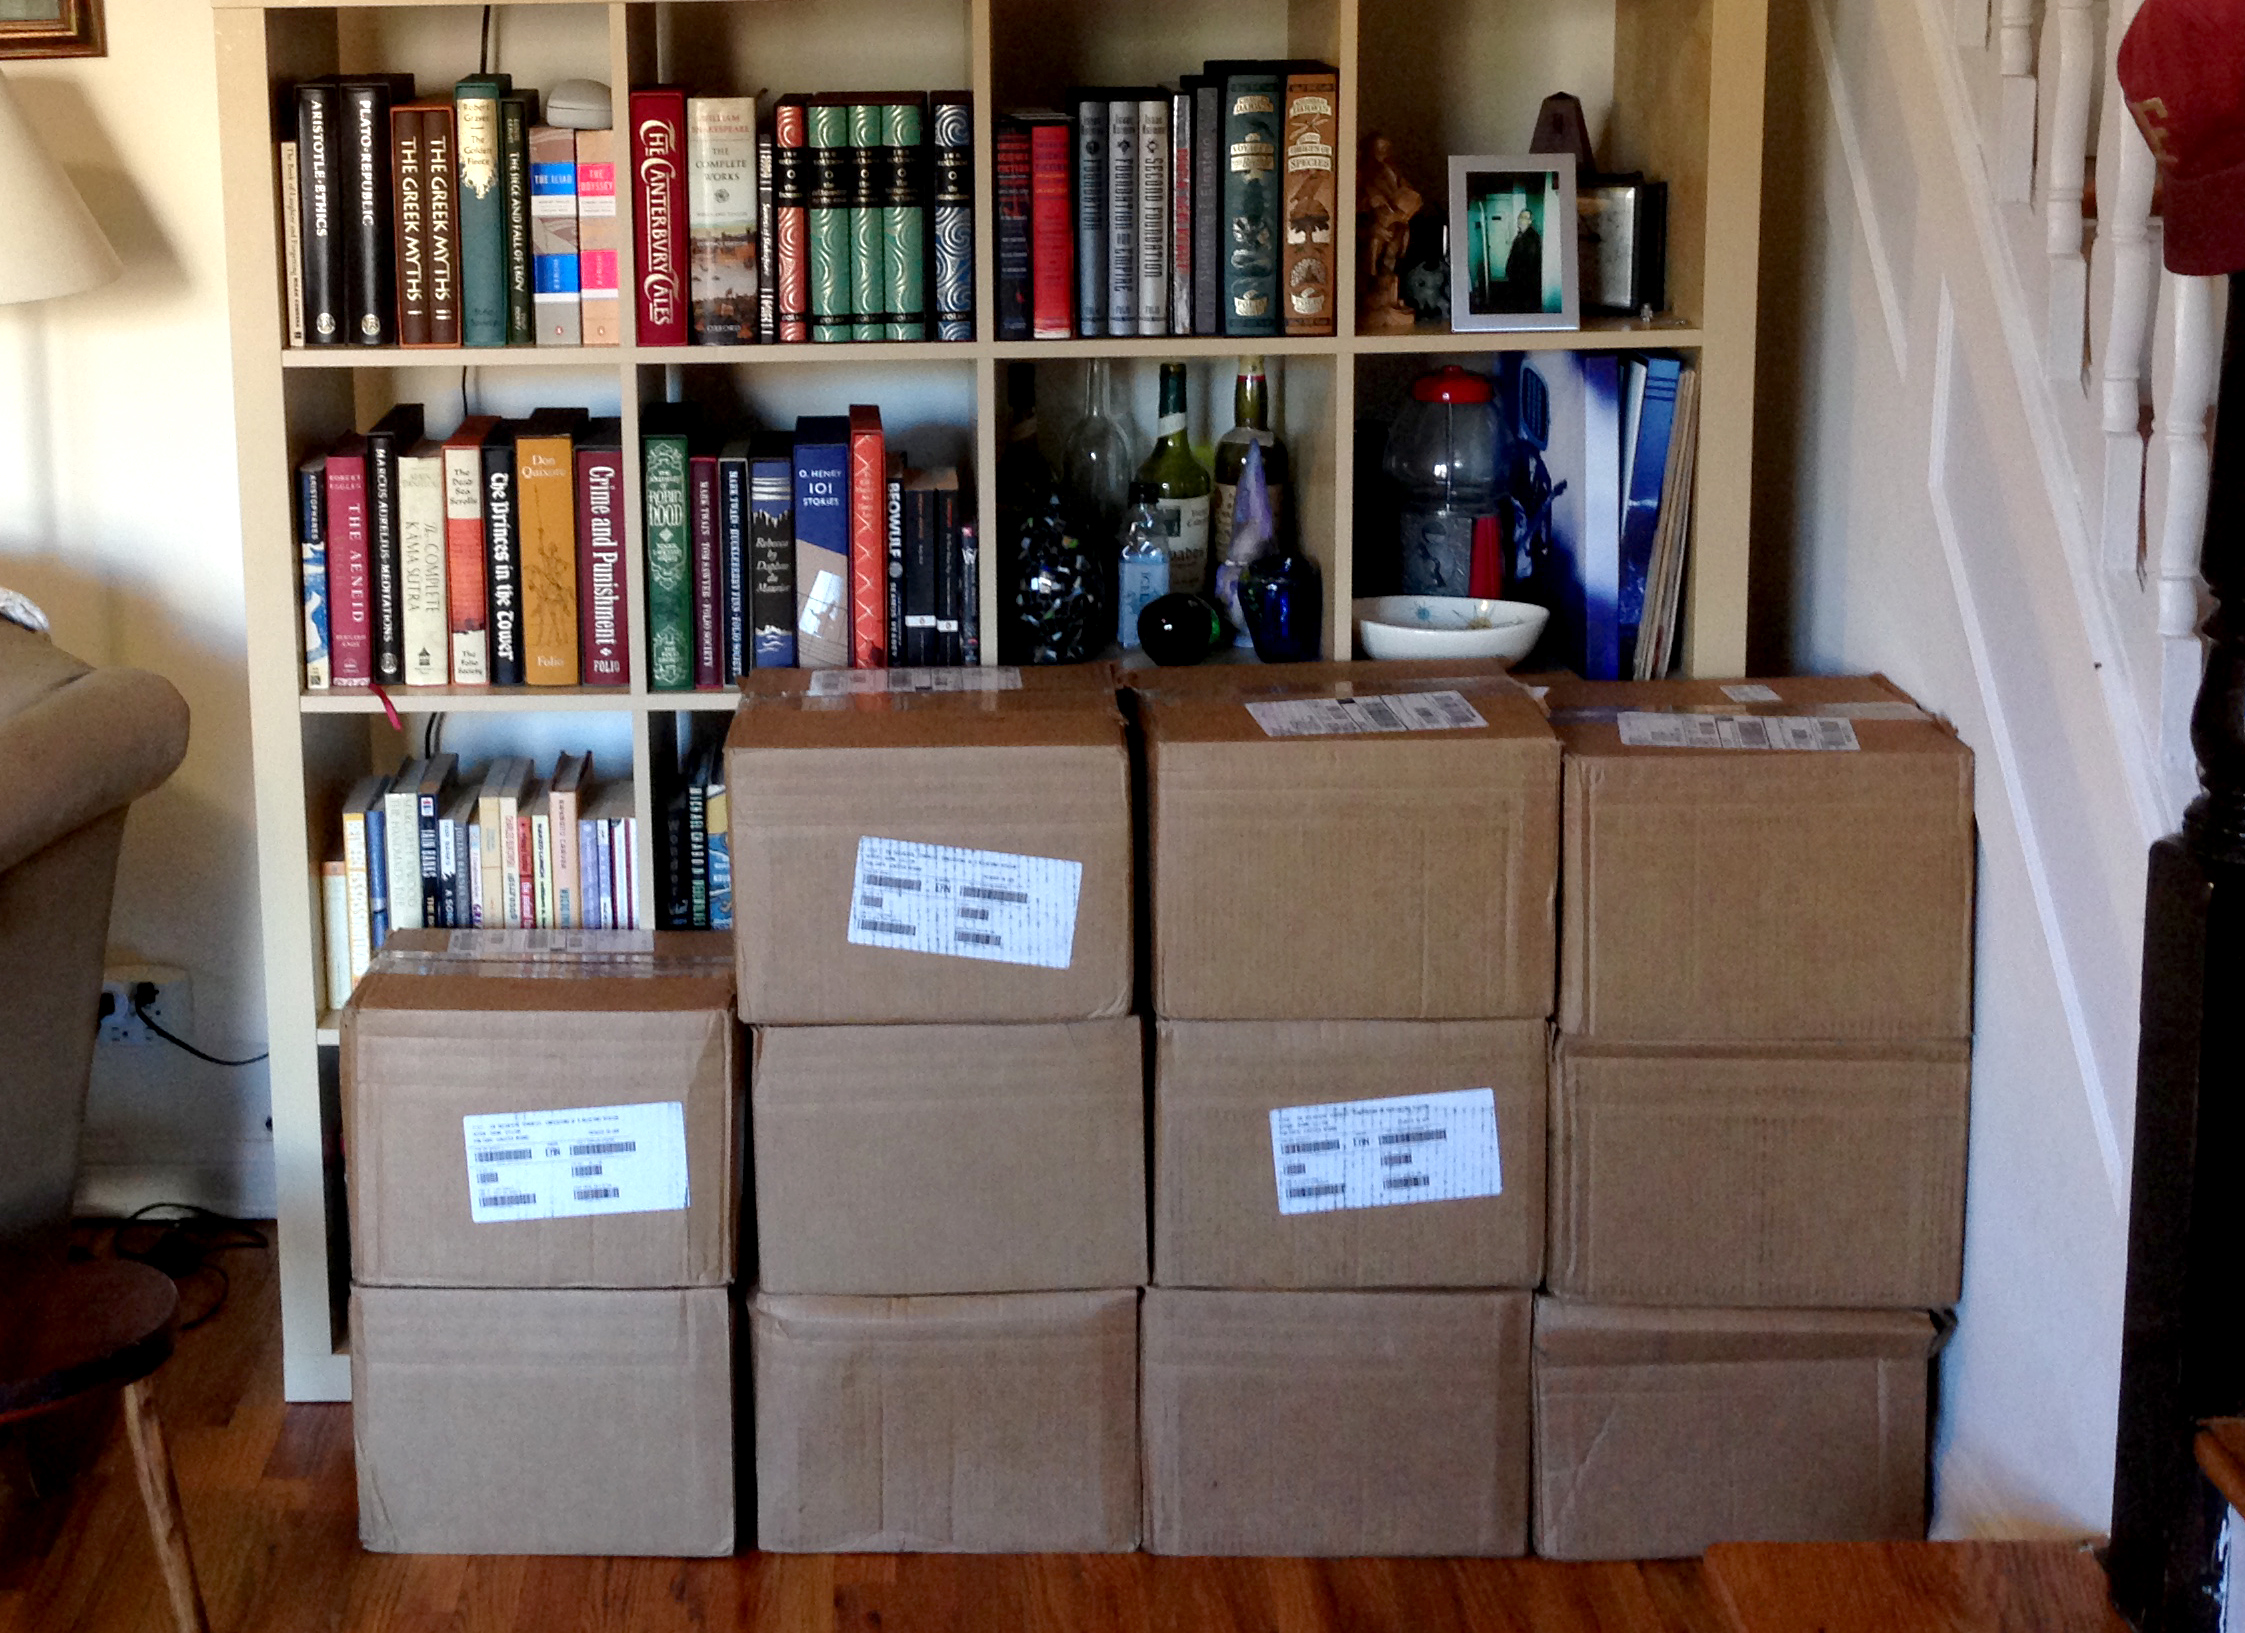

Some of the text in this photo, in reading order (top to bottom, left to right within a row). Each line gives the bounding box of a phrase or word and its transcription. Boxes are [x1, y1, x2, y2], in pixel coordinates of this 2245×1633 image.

[401, 136, 418, 173] THE
[430, 136, 447, 173] THE
[464, 146, 492, 154] Golden
[470, 136, 485, 144] The
[639, 119, 676, 157] THE
[712, 147, 729, 156] THE
[534, 174, 549, 185] THE
[589, 169, 604, 179] THE
[695, 160, 747, 169] COMPLETE
[705, 173, 740, 181] WORKS
[1289, 158, 1330, 170] SPECIES
[402, 177, 420, 232] GREEK
[431, 176, 448, 232] GREEK
[580, 181, 613, 192] ODYSSEY
[1083, 157, 1103, 232] FOUNDATION
[1114, 157, 1134, 230] FOUNDATION
[509, 152, 525, 292] THE SIEGE AND FALL OF TROY
[1143, 157, 1164, 278] SECOND FOUNDATION
[404, 236, 422, 301] MYTHS
[433, 235, 450, 301] MYTHS
[1114, 248, 1134, 293] EMPIRE
[643, 270, 679, 325] TALES
[706, 324, 742, 332] OXFORD
[521, 465, 567, 479] Quixote
[532, 454, 556, 466] Don
[811, 469, 842, 478] HENRY
[802, 497, 840, 507] STORIES
[809, 482, 832, 495] 101
[888, 482, 902, 559] BEOWULF
[348, 502, 365, 623] THE AENEID
[375, 448, 393, 643] MARCUS AURELIUS MEDITATIONS
[588, 465, 620, 646] Crime and Punishment
[405, 521, 421, 612] KAMA SUTRA
[424, 543, 440, 613] COMPLETE
[489, 472, 515, 662] The Princes in the Tower
[537, 655, 565, 667] Folio
[593, 659, 621, 673] FOLIO
[421, 850, 437, 878] BANKS
